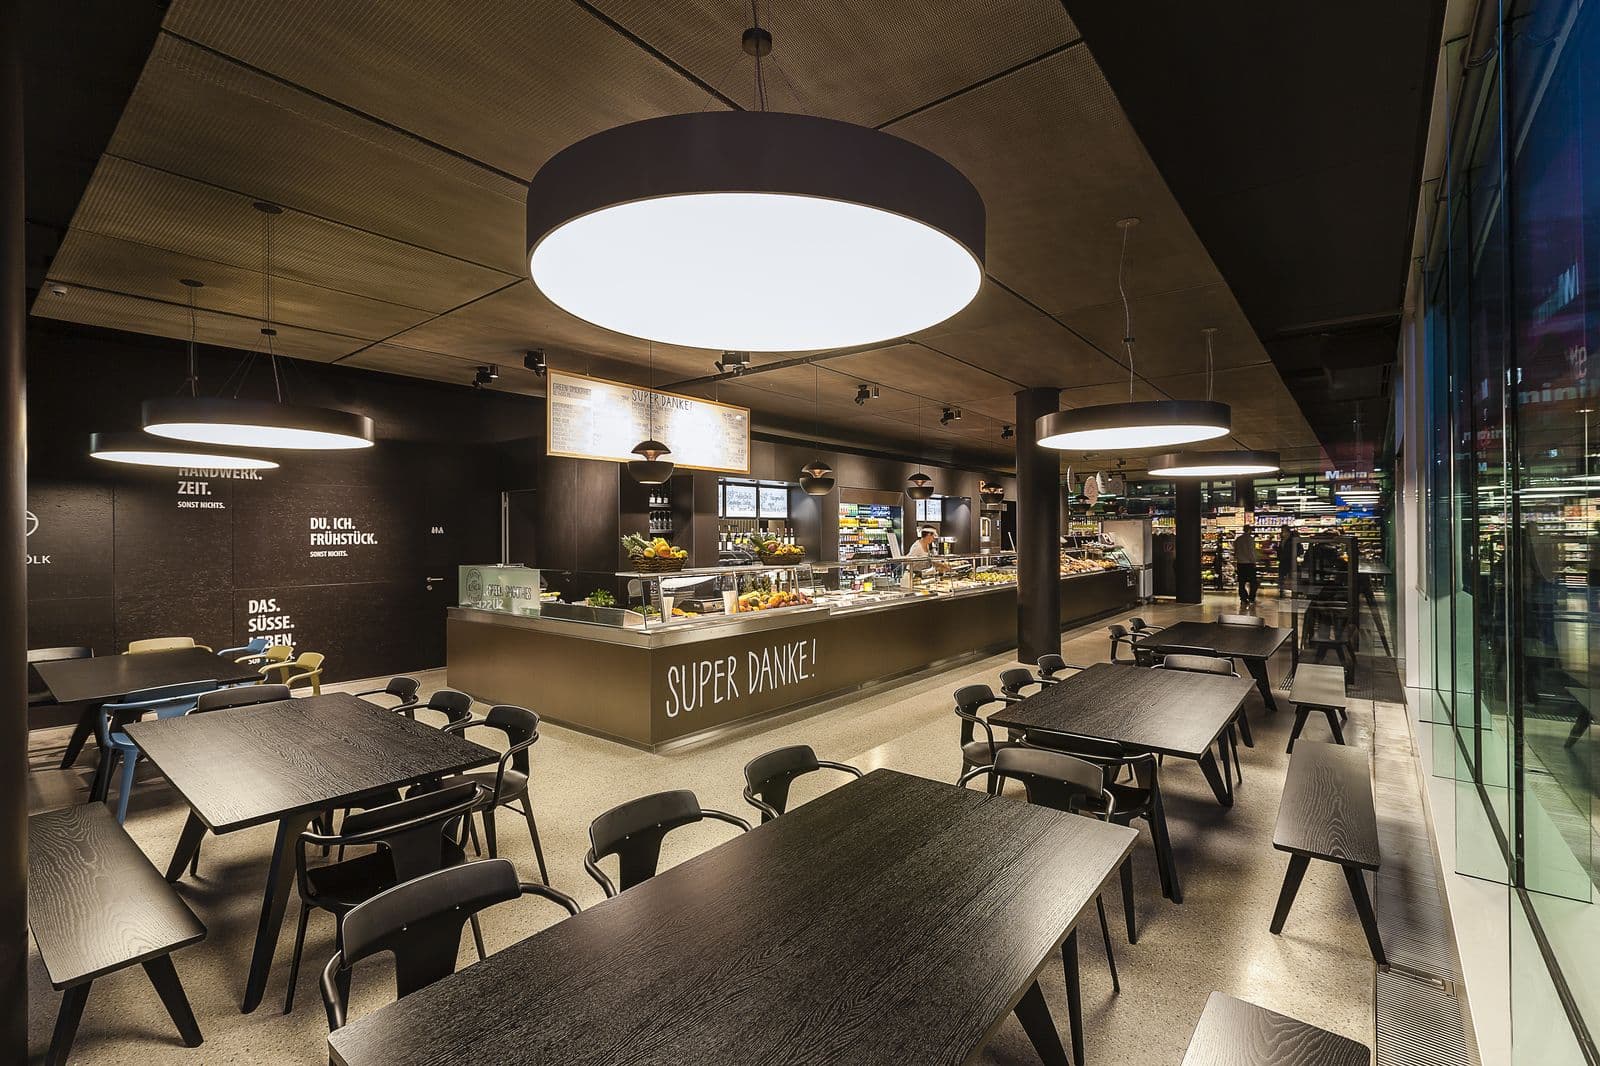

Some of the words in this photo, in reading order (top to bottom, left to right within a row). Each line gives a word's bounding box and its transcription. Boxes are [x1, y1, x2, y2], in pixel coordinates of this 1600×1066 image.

[632, 389, 659, 406] SUPER
[661, 396, 693, 411] DANKE!
[177, 481, 212, 496] ZEIT.
[177, 501, 199, 509] SONST
[200, 502, 226, 510] NICHTS.
[310, 517, 331, 530] DU.
[333, 517, 356, 530] ICH.
[310, 531, 378, 546] FRÜHSTÜCK.
[248, 598, 281, 614] DAS.
[248, 614, 295, 632] SÜSSE.
[249, 633, 297, 649] BEN.
[665, 655, 740, 719] SUPER
[747, 638, 817, 696] DANKE!
